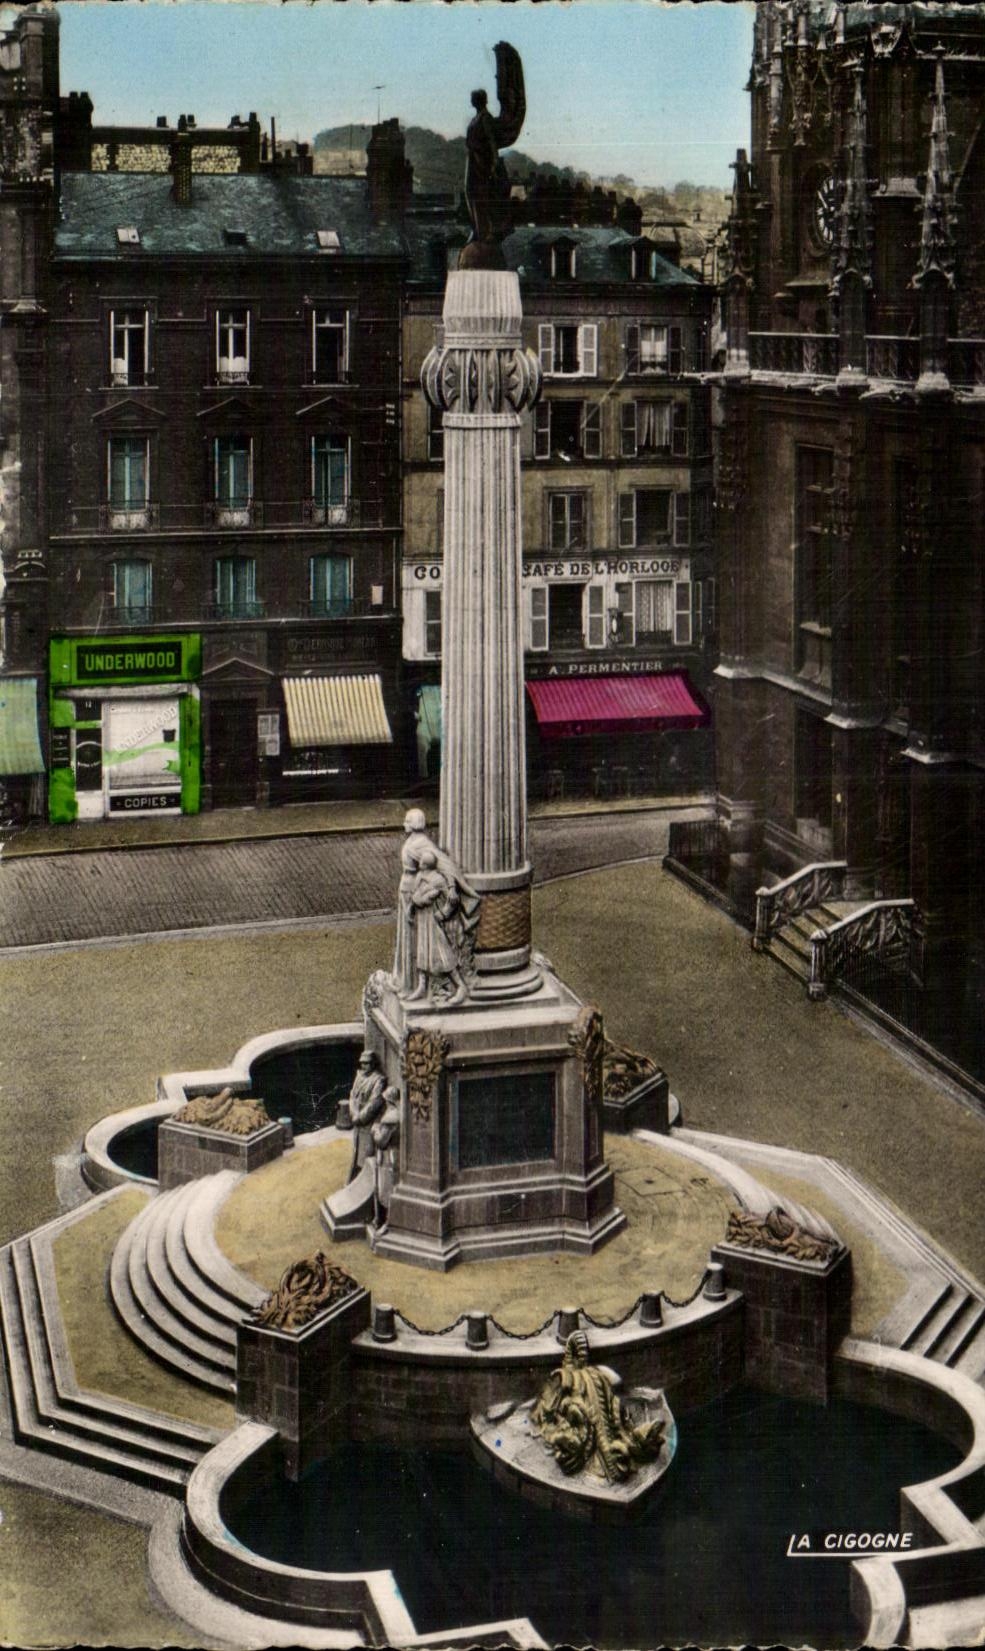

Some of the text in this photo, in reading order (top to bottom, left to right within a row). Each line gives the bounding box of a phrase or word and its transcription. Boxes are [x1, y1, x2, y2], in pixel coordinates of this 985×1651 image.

[569, 562, 591, 576] DE
[84, 651, 176, 672] UNDERWOOD
[568, 661, 663, 675] PERMENTIER
[124, 796, 168, 809] COPIES
